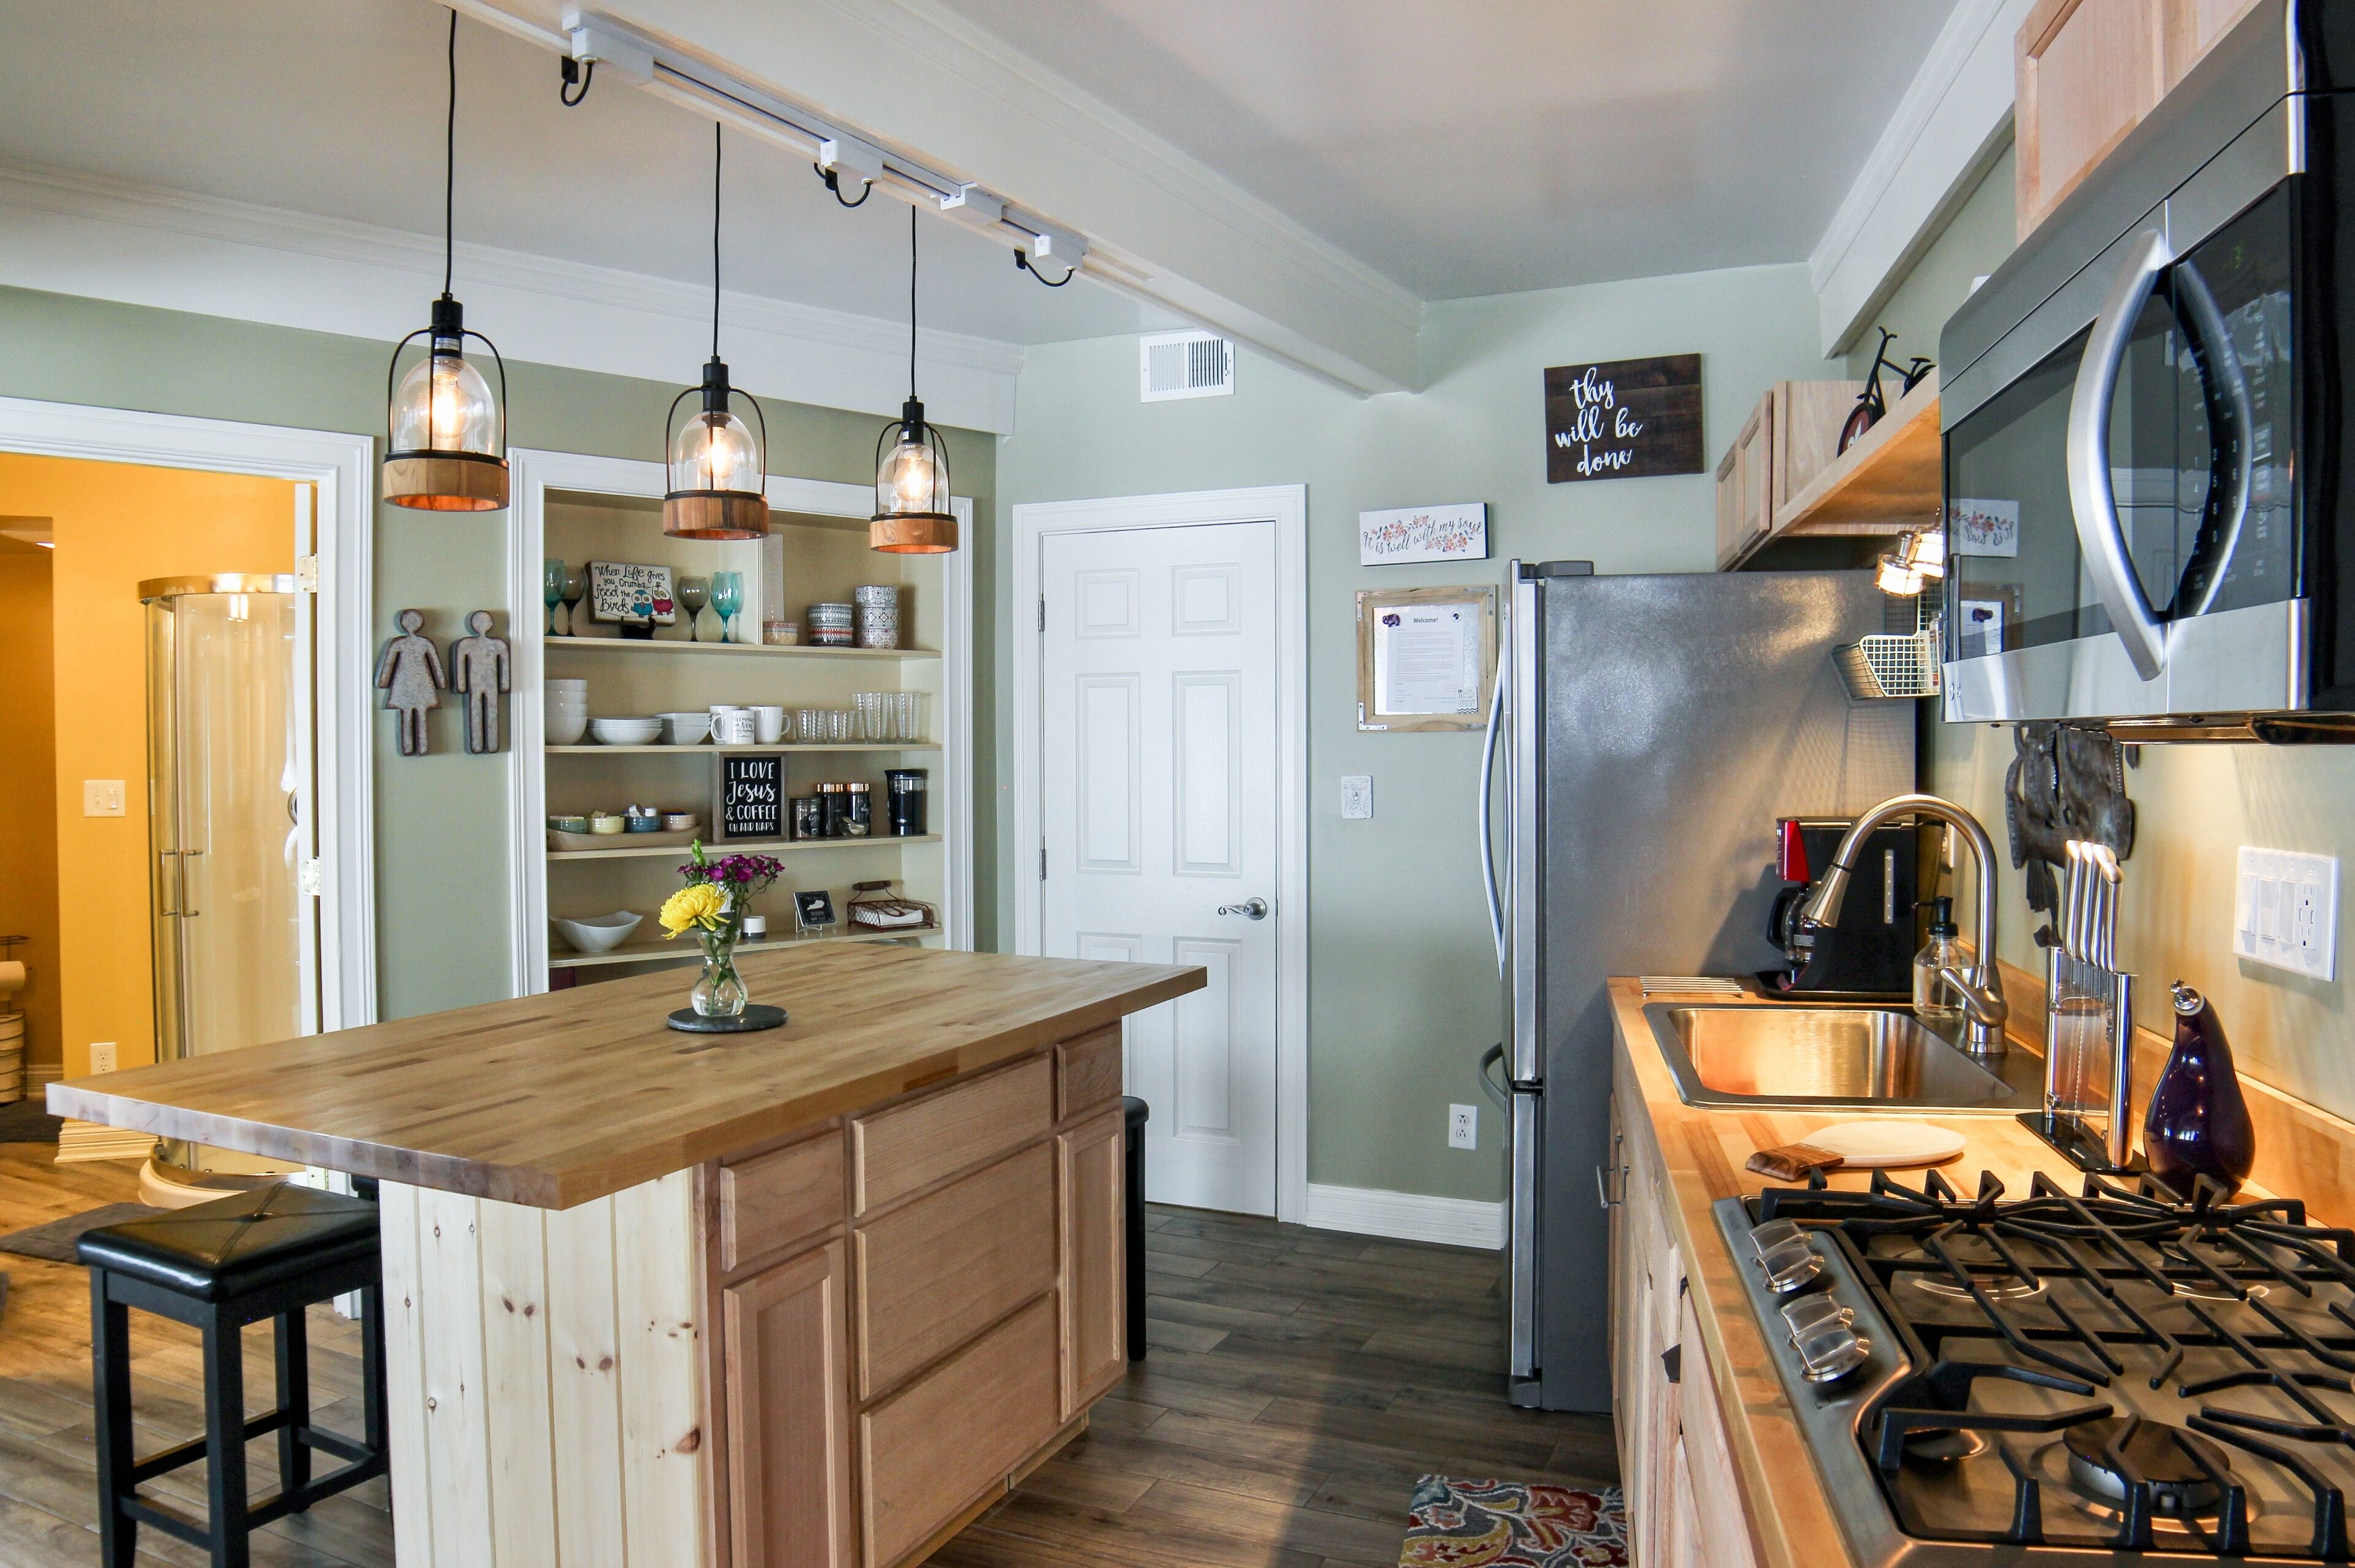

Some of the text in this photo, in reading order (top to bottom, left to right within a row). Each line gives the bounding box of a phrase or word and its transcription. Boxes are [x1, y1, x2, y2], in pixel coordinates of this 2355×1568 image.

[1569, 367, 1614, 410] thy
[1555, 405, 1644, 448] will be
[2213, 448, 2218, 461] 2
[2232, 440, 2237, 453] 3
[1576, 444, 1633, 476] done
[2213, 476, 2218, 488] 5
[1363, 518, 1483, 554] It is well with my soul
[595, 564, 665, 584] When Life gives
[603, 578, 615, 586] you
[594, 584, 630, 599] feed the
[599, 597, 629, 614] Birds
[730, 762, 775, 779] I LOVE
[726, 781, 776, 805] Jesus
[726, 805, 778, 820] & COFFEE
[729, 822, 774, 832] OH AND NAPS
